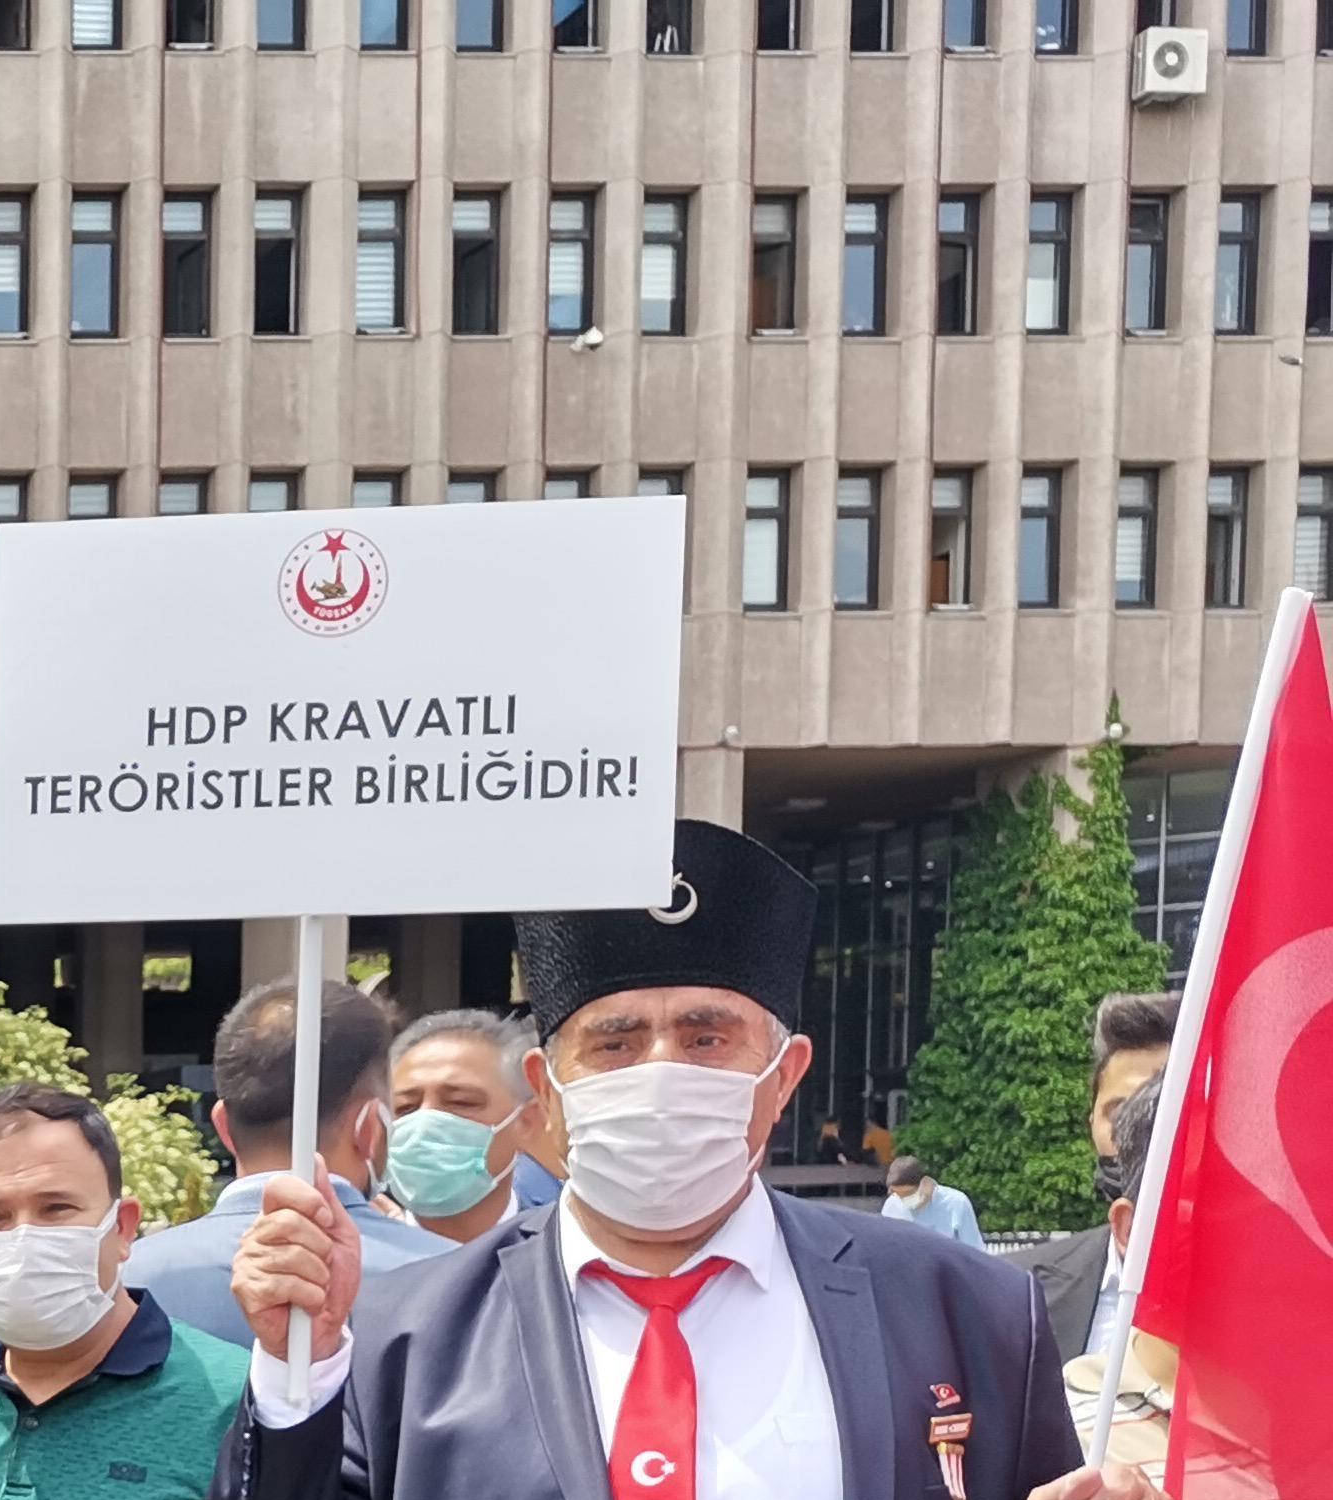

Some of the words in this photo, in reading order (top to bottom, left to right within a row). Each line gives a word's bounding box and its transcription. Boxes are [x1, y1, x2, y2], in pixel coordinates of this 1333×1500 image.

[148, 706, 246, 746] HDP
[270, 695, 515, 741] KRAVATLI
[25, 761, 331, 814] TERÖRİSTLER
[356, 748, 637, 804] BİRLİĞİDİR!
